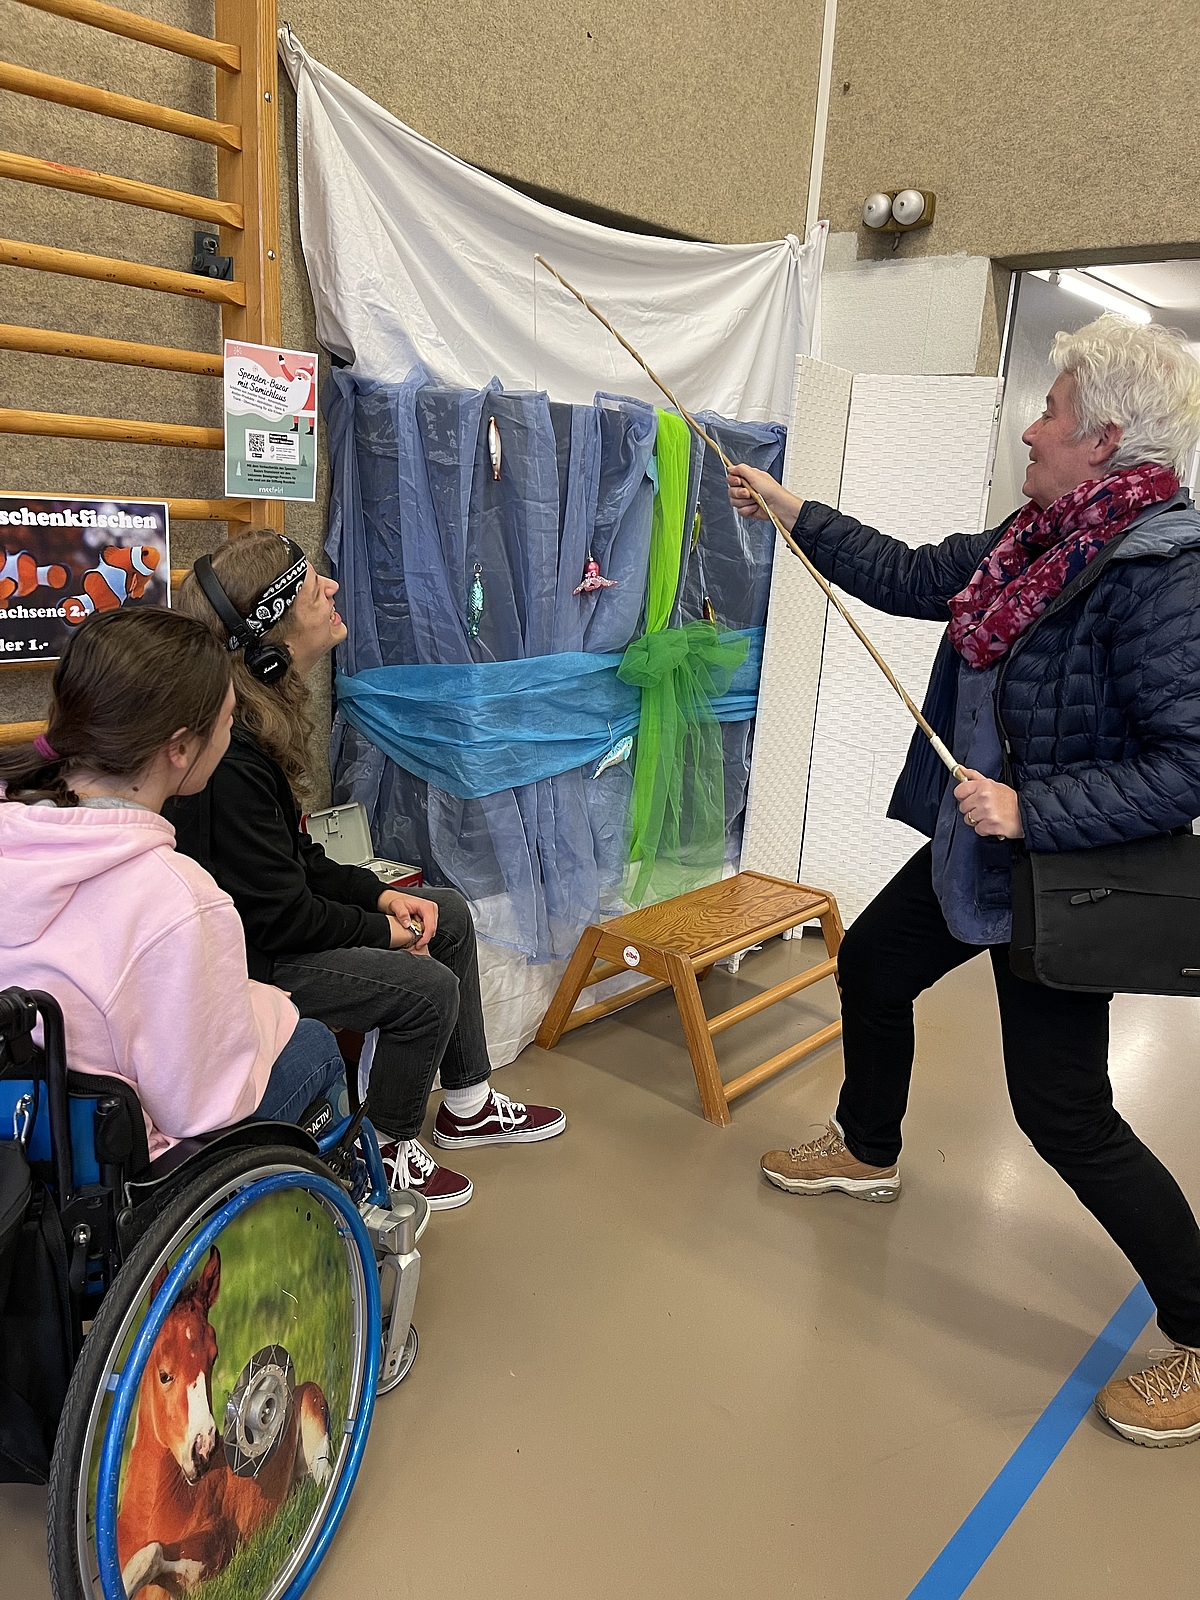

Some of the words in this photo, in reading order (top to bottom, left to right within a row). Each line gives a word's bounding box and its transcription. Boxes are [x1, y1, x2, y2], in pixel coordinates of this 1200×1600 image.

[237, 380, 248, 390] mit
[250, 382, 286, 402] Samichlaus
[238, 368, 289, 392] Spenden-Bazar
[0, 605, 66, 619] achsene
[28, 638, 49, 650] 1.-
[312, 1108, 330, 1134] ACTIV
